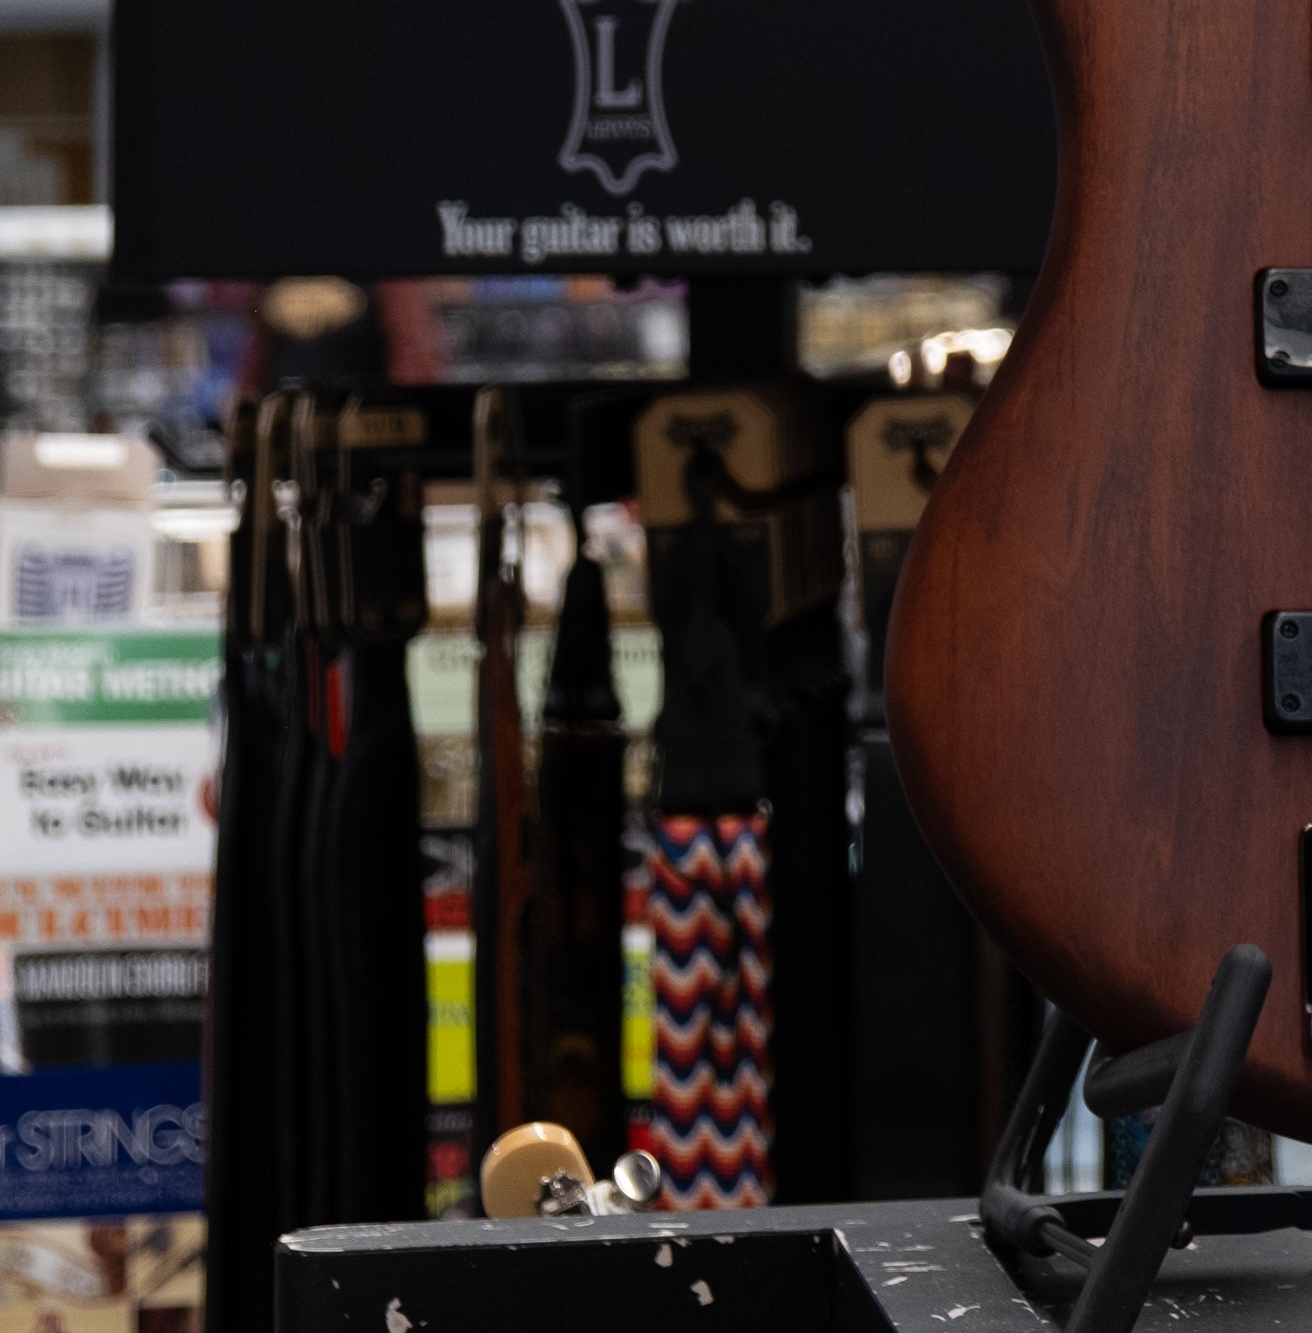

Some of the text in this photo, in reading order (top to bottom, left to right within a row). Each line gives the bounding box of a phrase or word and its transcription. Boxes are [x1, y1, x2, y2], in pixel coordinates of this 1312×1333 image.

[436, 197, 813, 264] Your guitar is worth it.
